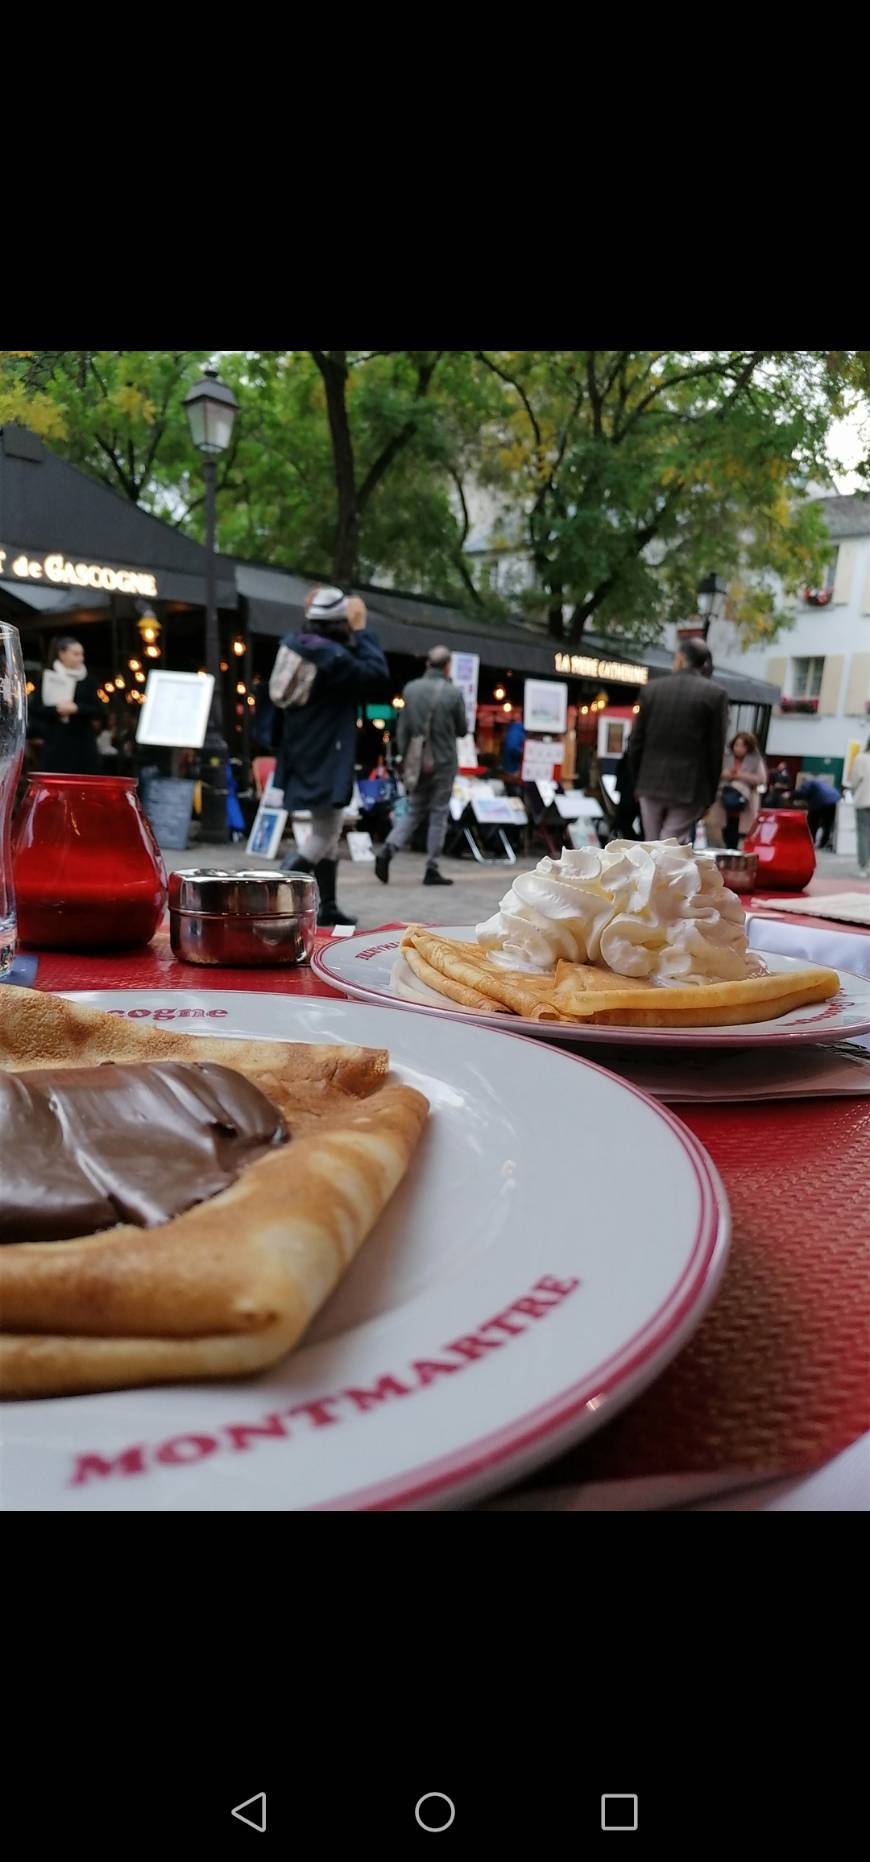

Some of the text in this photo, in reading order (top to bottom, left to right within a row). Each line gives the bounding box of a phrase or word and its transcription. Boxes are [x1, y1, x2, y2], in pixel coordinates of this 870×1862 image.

[12, 555, 43, 578] de
[44, 553, 158, 597] GASCOGNE
[555, 652, 571, 673] LA
[67, 1273, 583, 1488] MONTMARTRE
